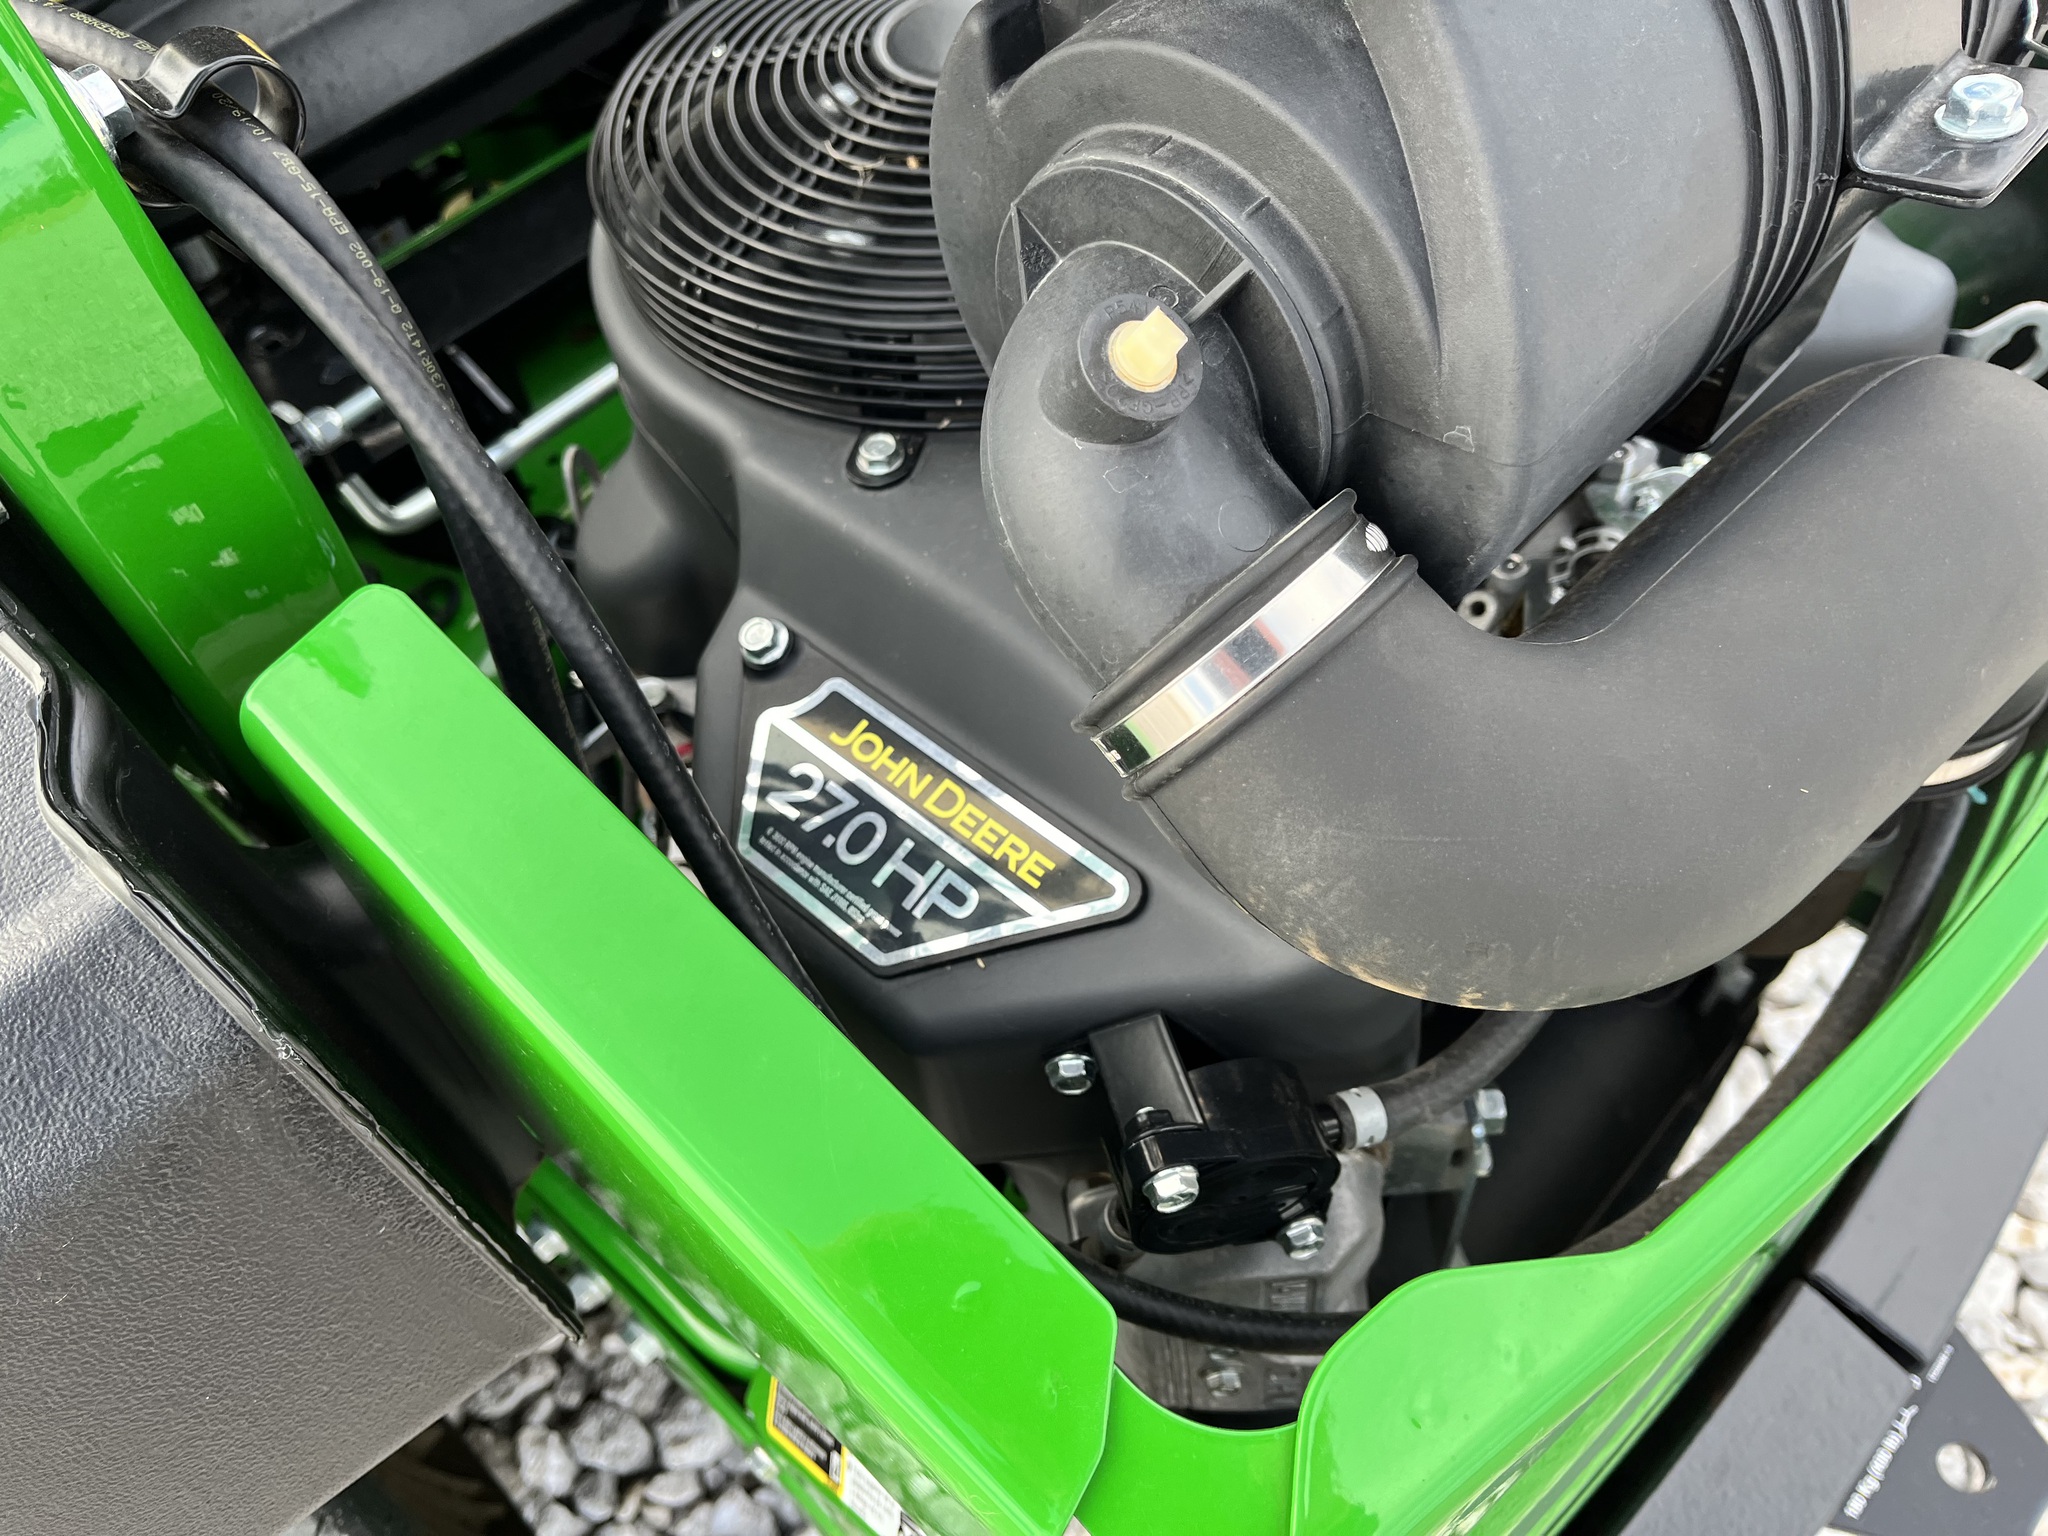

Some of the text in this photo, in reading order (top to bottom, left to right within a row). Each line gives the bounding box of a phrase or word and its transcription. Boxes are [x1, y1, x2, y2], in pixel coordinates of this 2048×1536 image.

[272, 150, 350, 236] EPA-15-GB7
[349, 242, 402, 314] Q-19-002
[401, 320, 446, 391] J30R14T2
[765, 762, 980, 921] 27.0 HP
[829, 719, 1056, 890] JOHN DEERE
